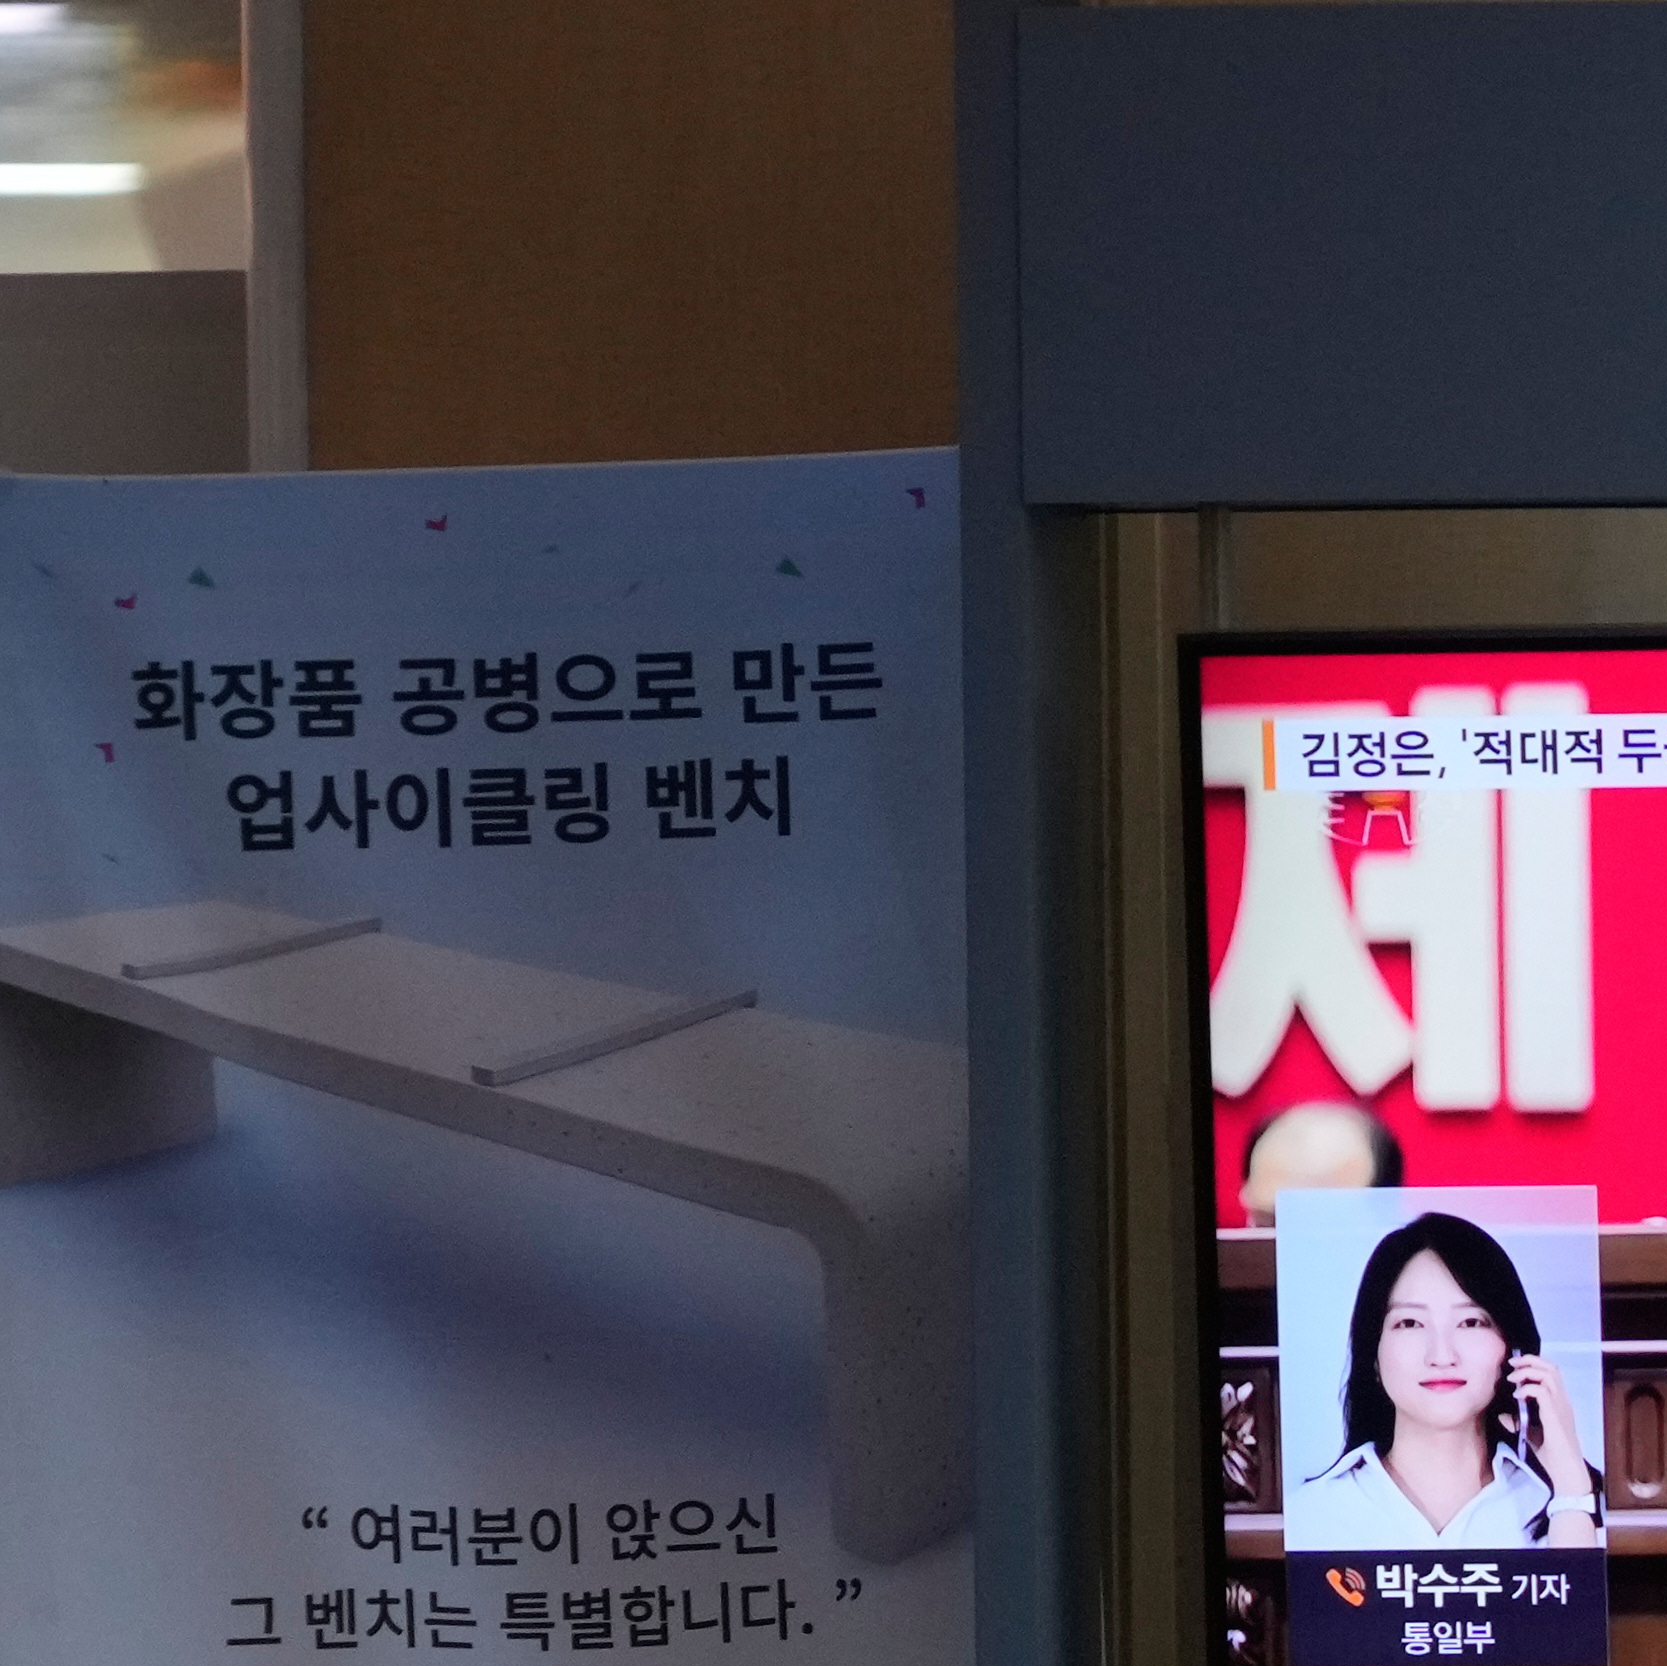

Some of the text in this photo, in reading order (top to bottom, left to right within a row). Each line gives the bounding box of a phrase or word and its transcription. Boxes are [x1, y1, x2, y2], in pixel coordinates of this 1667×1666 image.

[130, 641, 884, 742] 화장품 공병으로 만든
[1302, 730, 1446, 779] 김정은,
[1462, 728, 1603, 776] '적대적
[226, 755, 791, 852] 업사이클링 벤치
[605, 1492, 778, 1561] 앉으신
[1376, 1563, 1571, 1608] 박수주 기자
[226, 1597, 282, 1646] 그
[305, 1588, 477, 1650] 벤치는
[1401, 1621, 1496, 1656] 통일부
